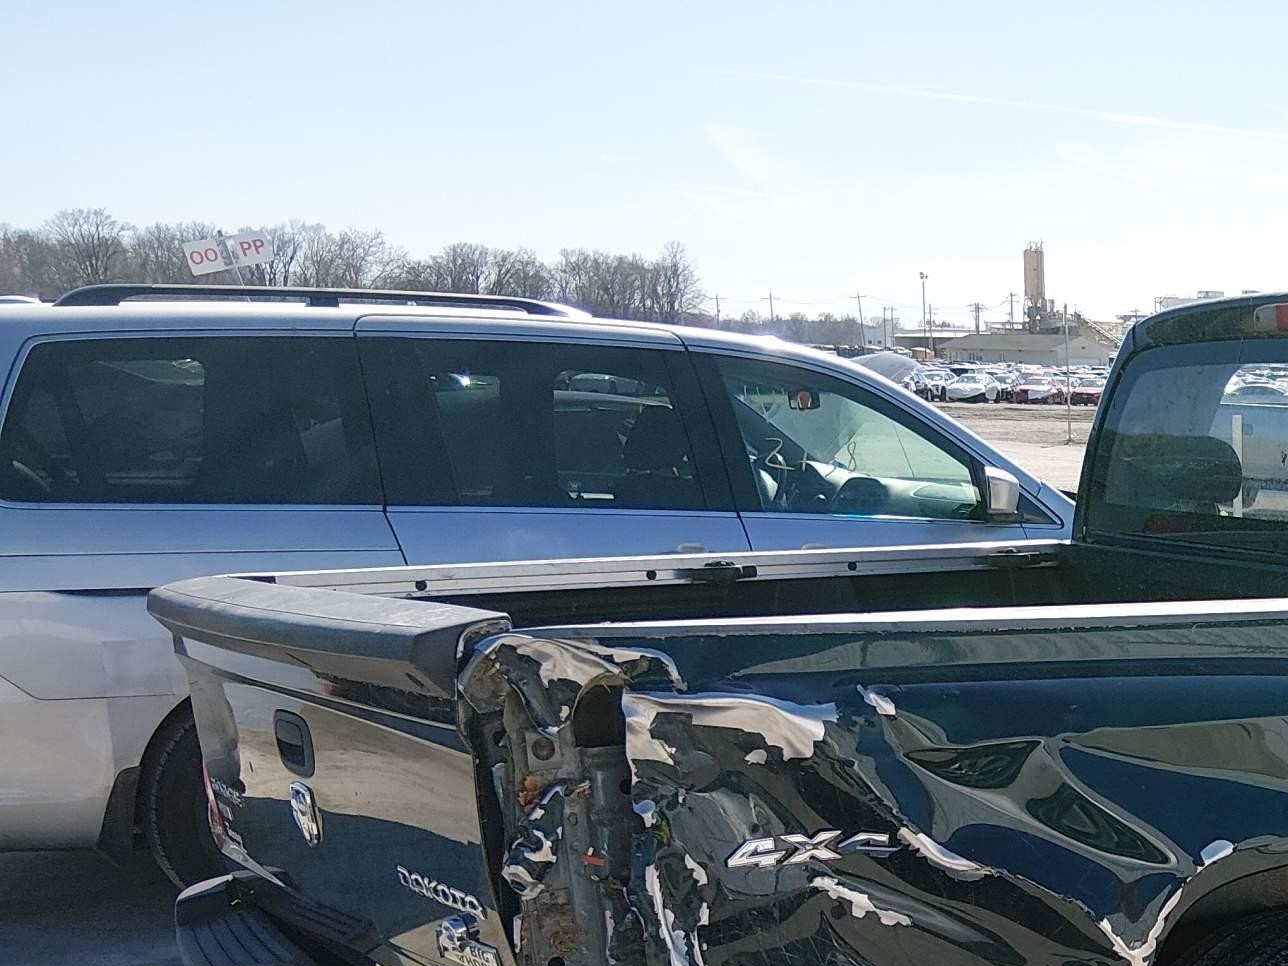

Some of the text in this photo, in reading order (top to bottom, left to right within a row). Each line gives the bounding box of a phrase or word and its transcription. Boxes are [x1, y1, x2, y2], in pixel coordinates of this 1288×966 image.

[189, 247, 219, 265] OO
[239, 238, 265, 257] PP
[396, 863, 487, 921] DAKOTA
